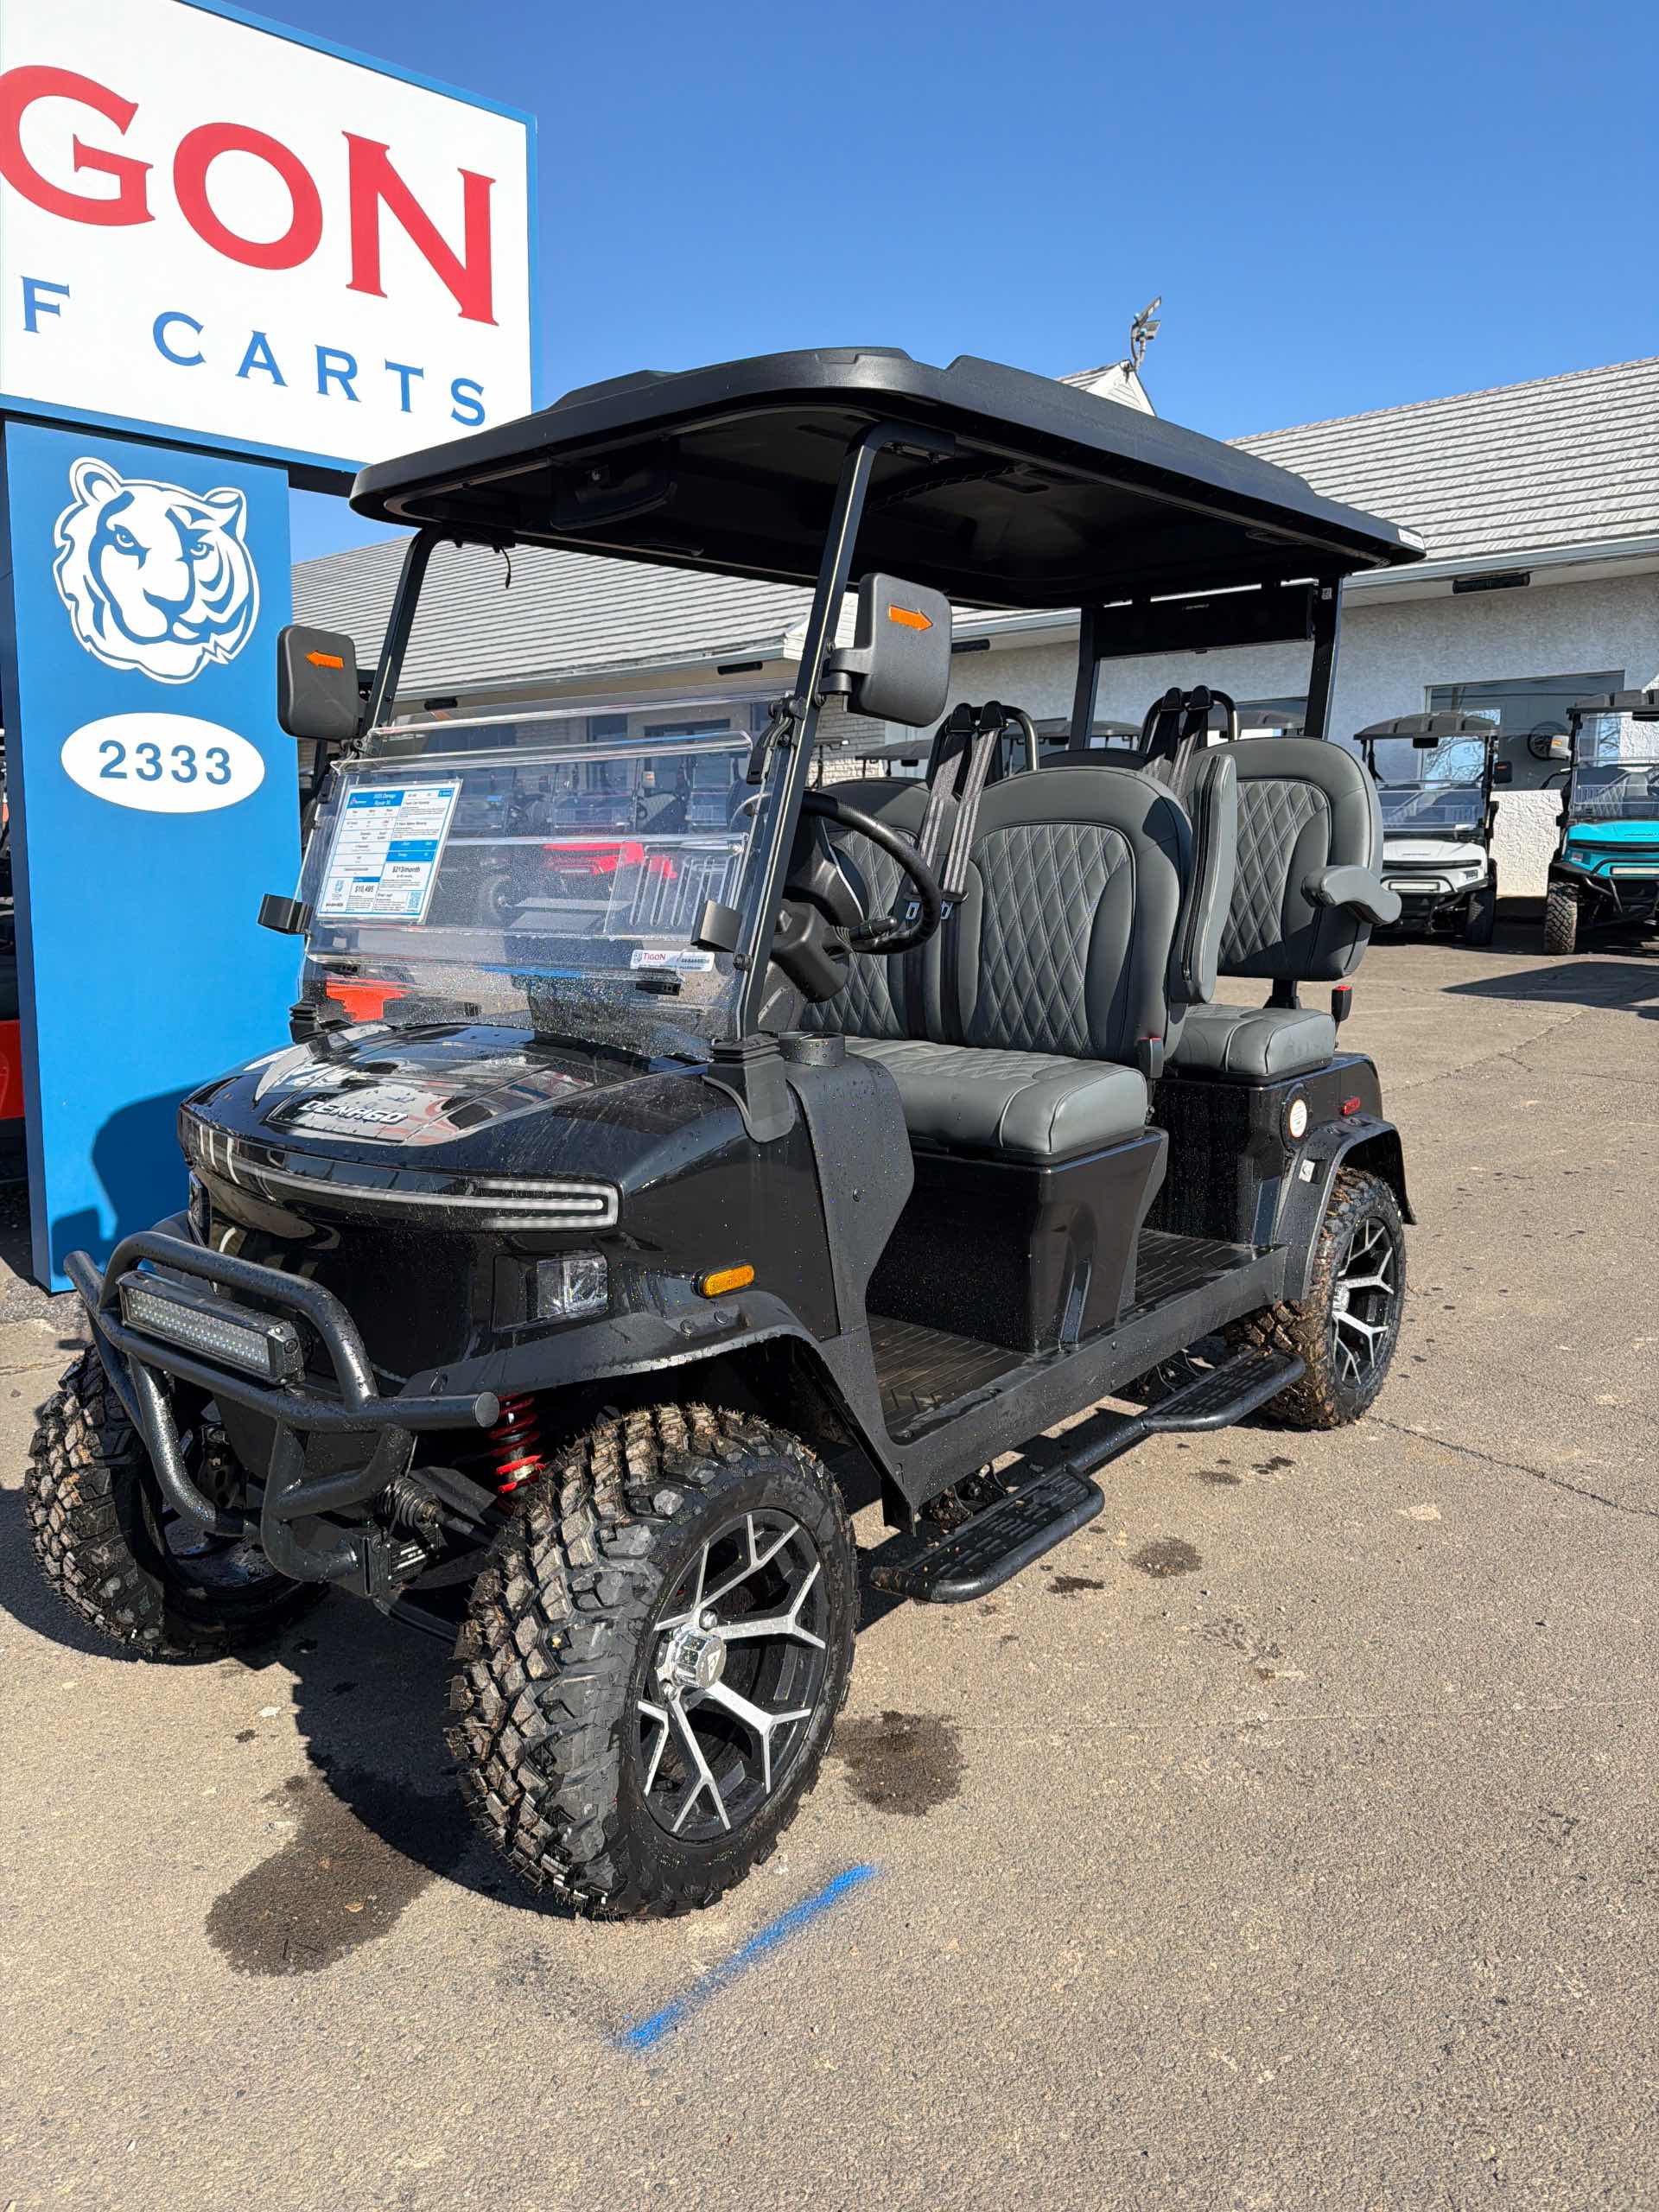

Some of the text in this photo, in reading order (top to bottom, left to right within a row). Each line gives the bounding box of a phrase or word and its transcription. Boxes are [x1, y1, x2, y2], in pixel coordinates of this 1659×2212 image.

[0, 65, 499, 327] GON
[21, 276, 486, 427] F CARTS
[99, 740, 232, 785] 2333
[298, 1100, 408, 1124] DENAGO
